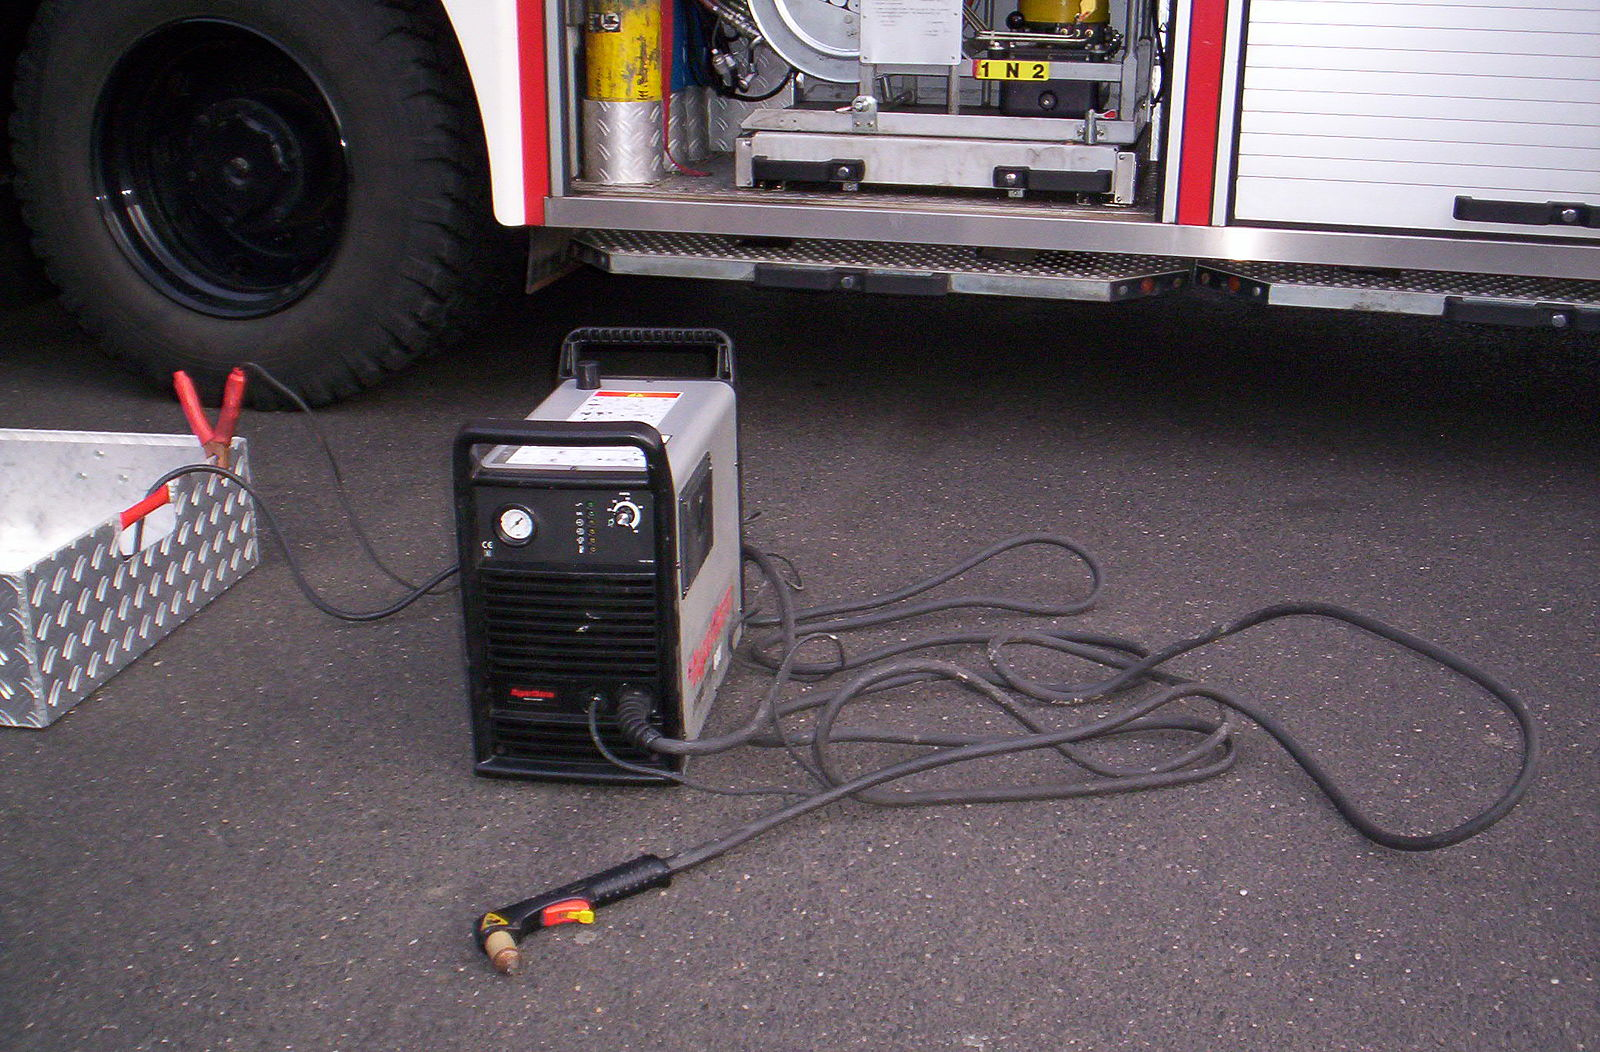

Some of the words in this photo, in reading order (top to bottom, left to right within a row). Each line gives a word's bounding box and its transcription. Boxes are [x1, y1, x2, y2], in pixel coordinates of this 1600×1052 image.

[981, 62, 989, 77] 1
[1006, 63, 1019, 78] N
[1033, 64, 1044, 78] 2
